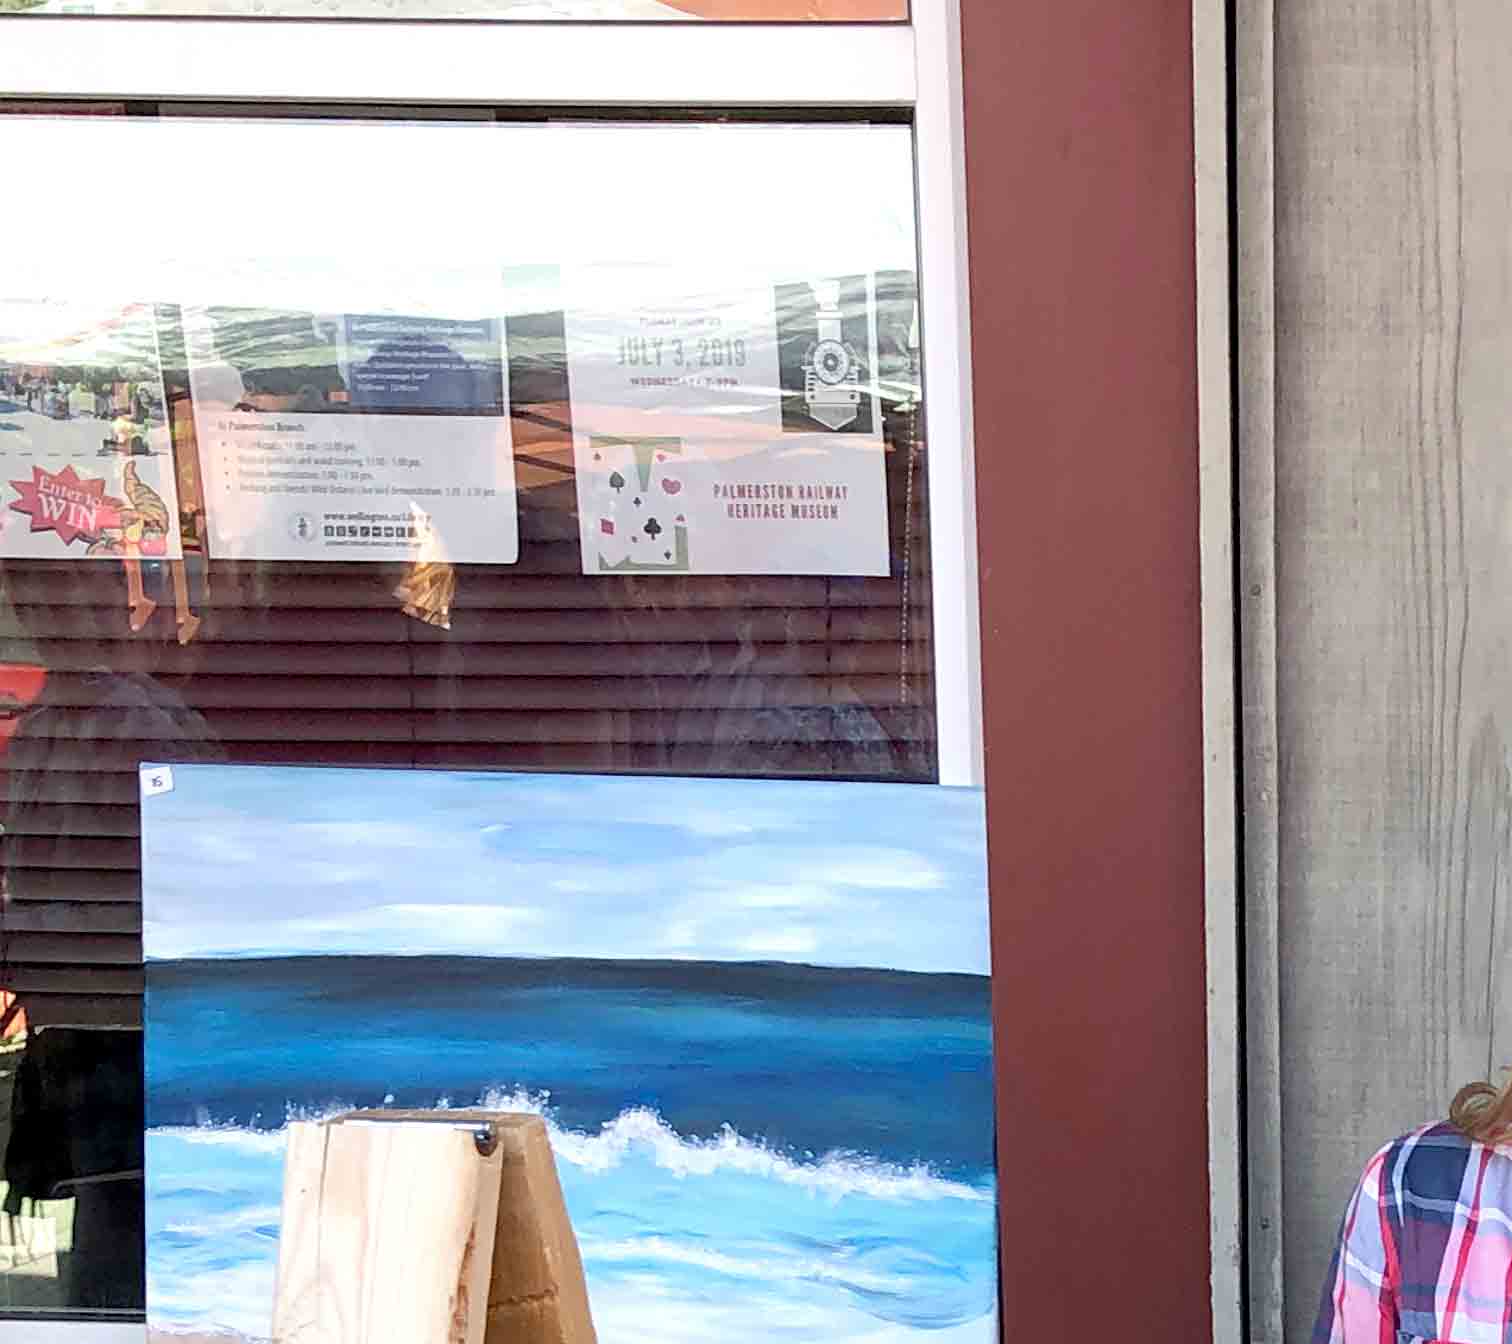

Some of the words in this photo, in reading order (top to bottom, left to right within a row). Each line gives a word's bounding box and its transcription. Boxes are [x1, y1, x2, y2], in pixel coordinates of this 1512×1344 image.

[38, 475, 82, 502] Enter
[713, 483, 793, 499] PALMERSTON
[799, 485, 848, 500] RAILWAY
[38, 493, 97, 531] WIN
[727, 503, 785, 519] HERITAGE
[791, 503, 839, 519] MUSEUM
